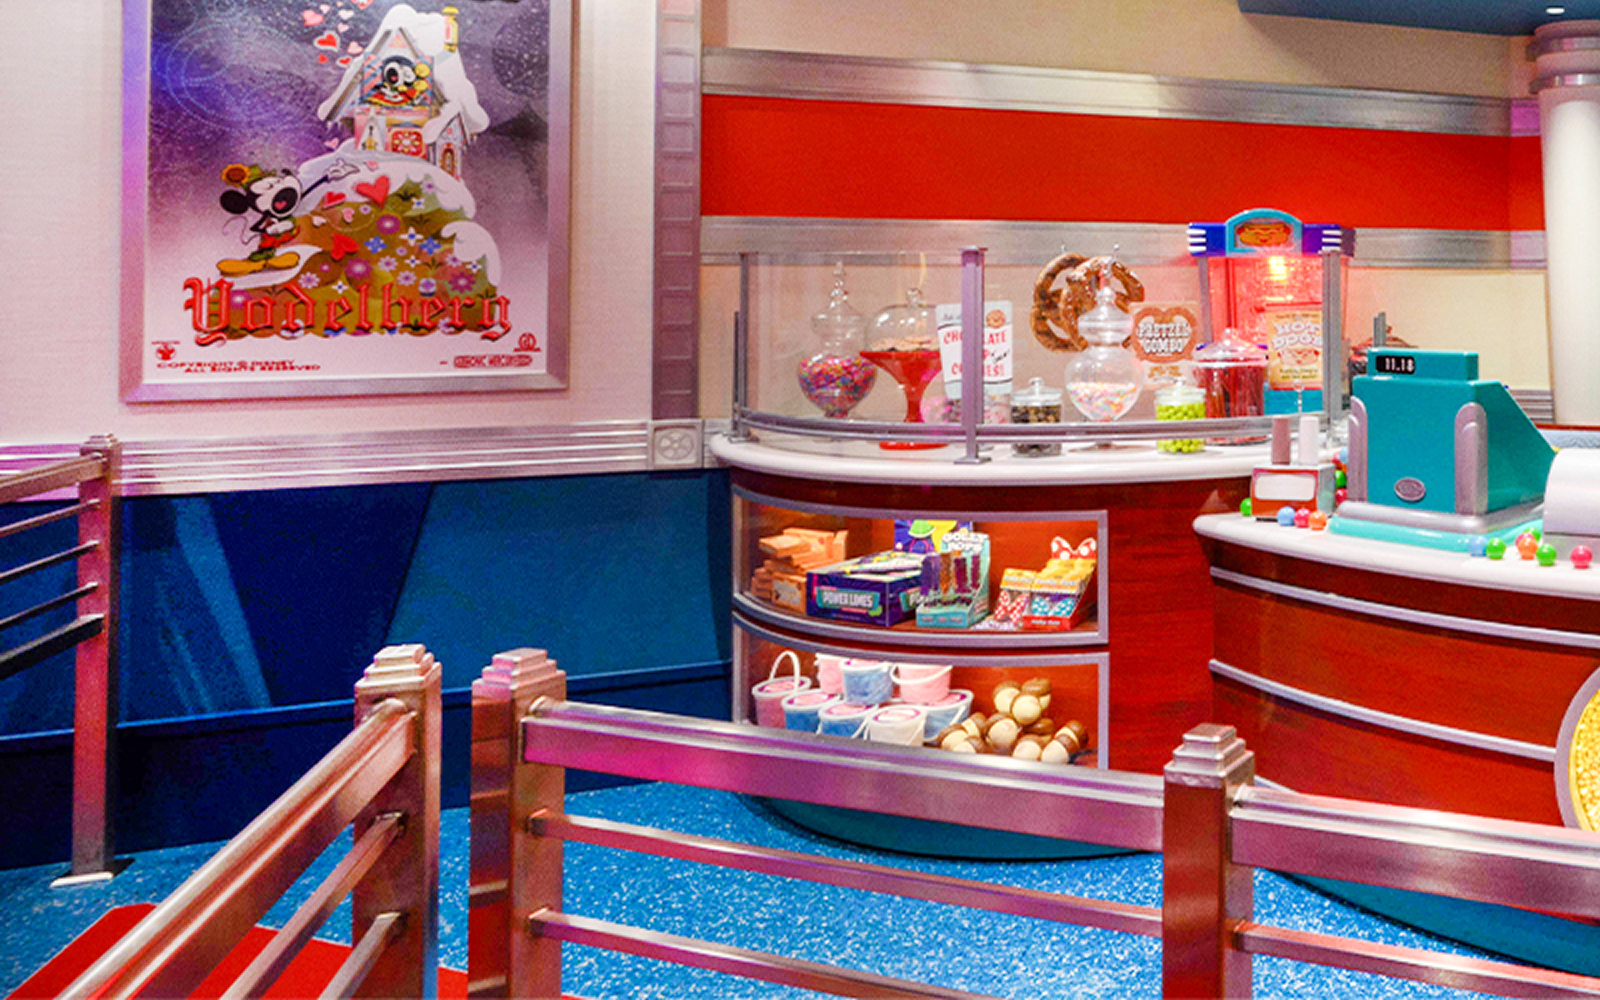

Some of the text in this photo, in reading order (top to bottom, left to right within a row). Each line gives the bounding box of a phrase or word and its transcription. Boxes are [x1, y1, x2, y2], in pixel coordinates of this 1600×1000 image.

[182, 277, 512, 347] Yodelberg
[1137, 322, 1191, 340] PRETZEL
[1274, 320, 1321, 336] HOT
[1385, 357, 1414, 373] 11.18
